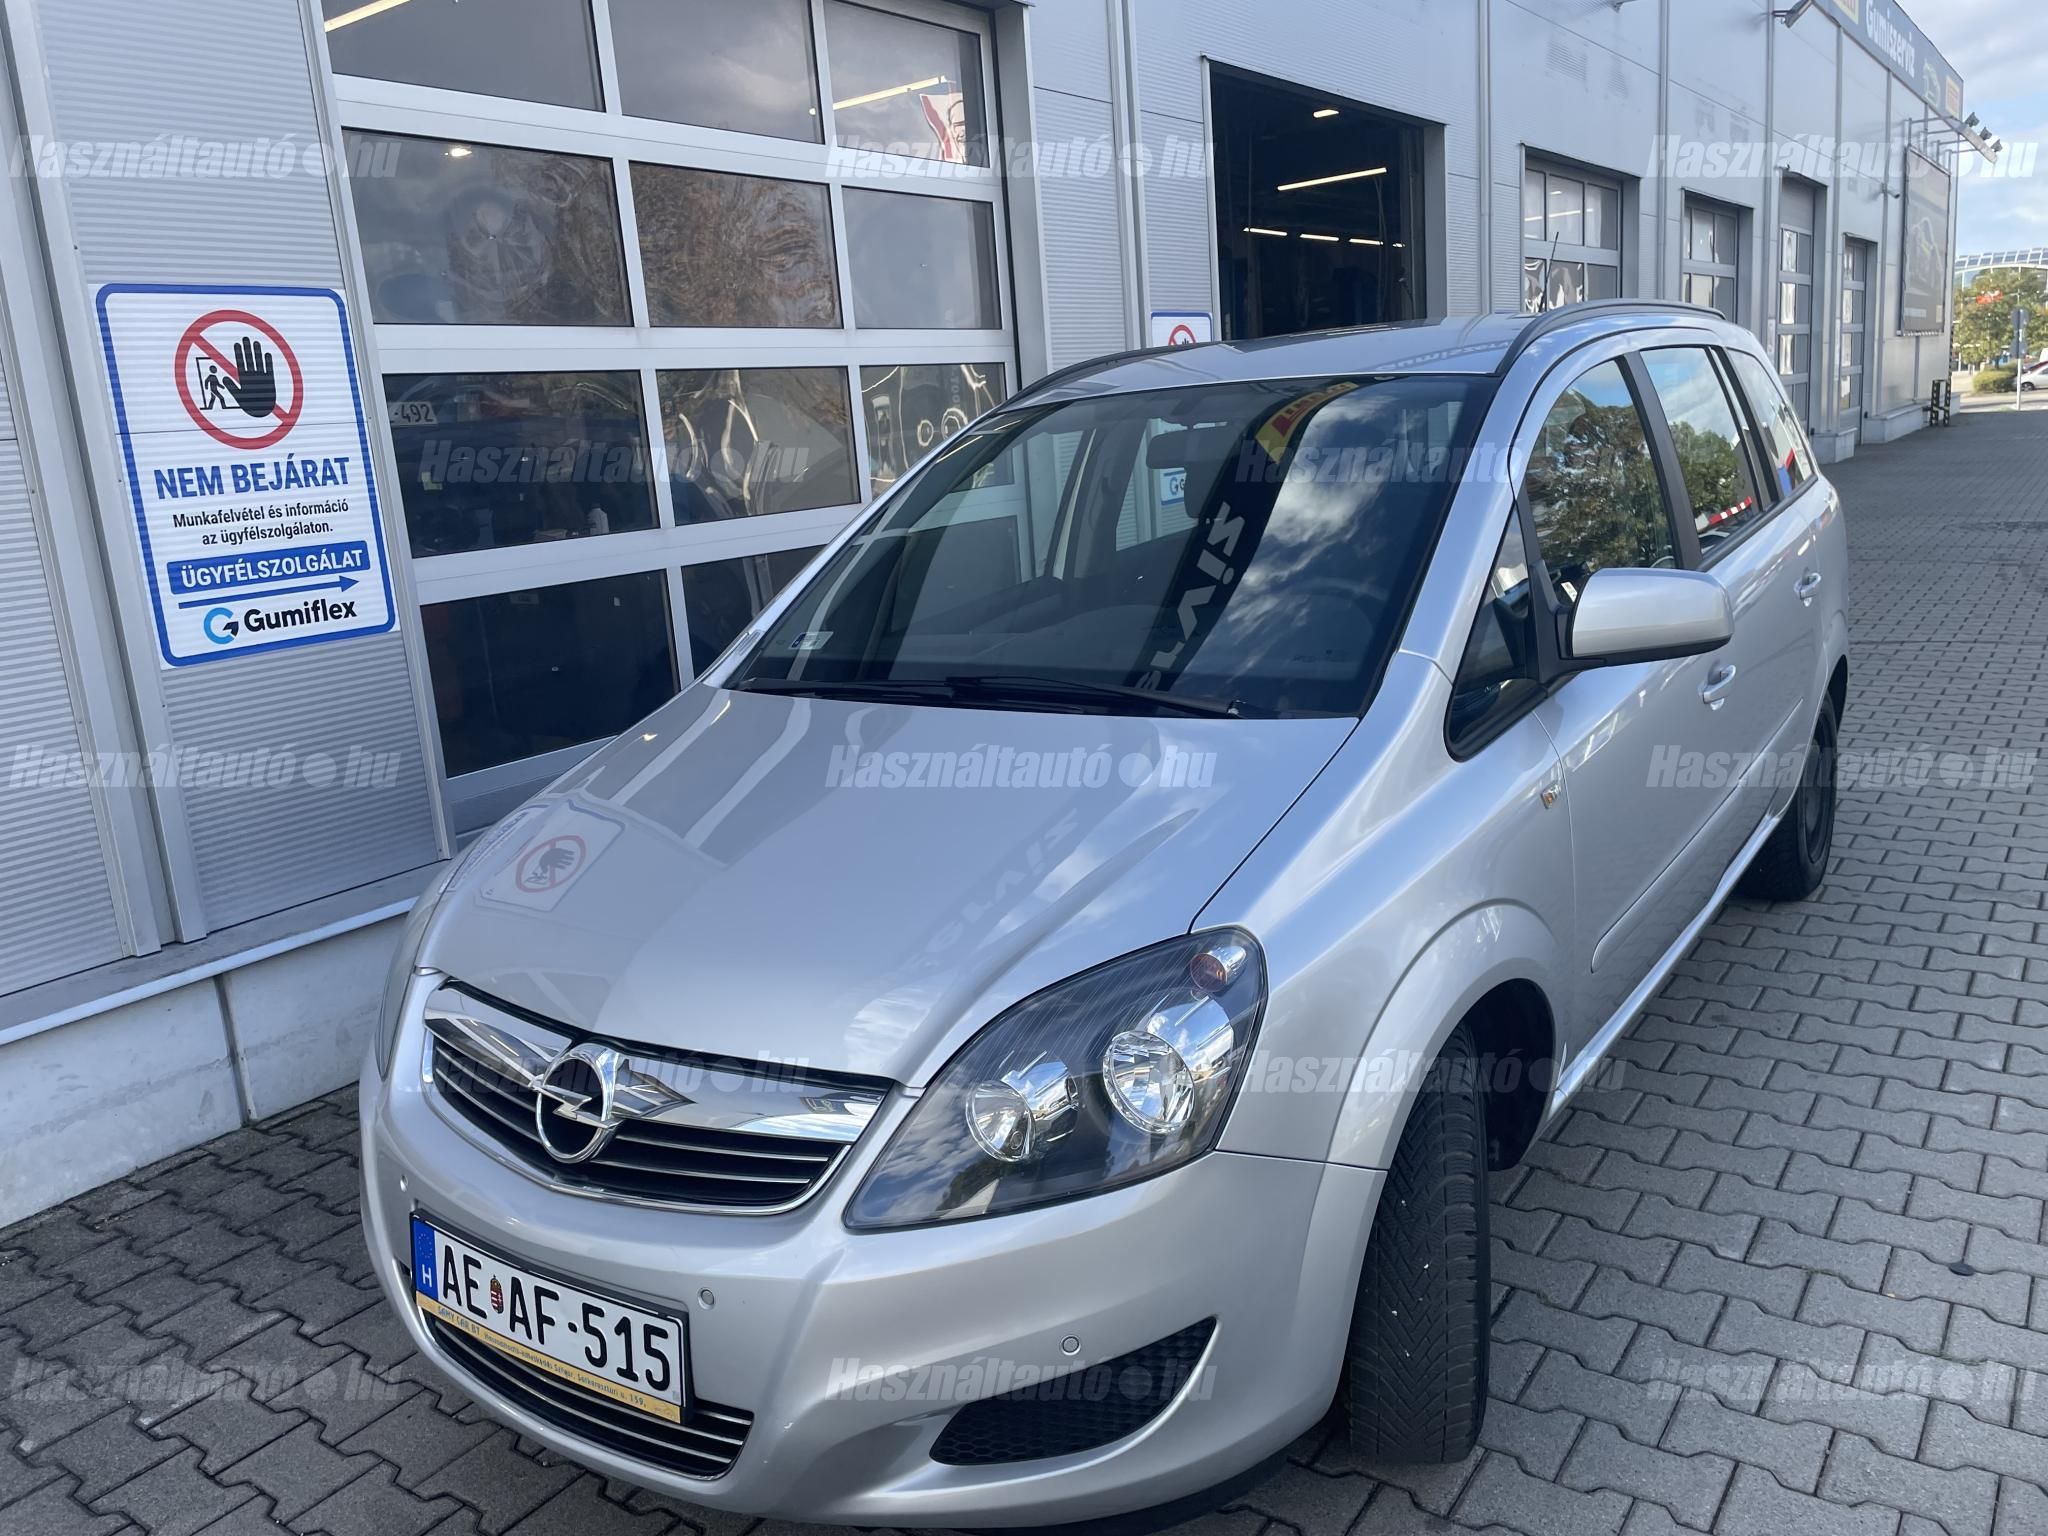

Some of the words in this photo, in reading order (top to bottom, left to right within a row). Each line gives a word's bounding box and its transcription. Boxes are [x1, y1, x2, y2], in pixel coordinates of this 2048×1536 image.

[1865, 0, 1915, 78] Gumiszerviz
[154, 465, 225, 500] NEM
[231, 453, 350, 493] BEJÁRAT
[173, 504, 265, 528] Munkafelvétel
[268, 503, 283, 519] és
[285, 499, 349, 517] információ
[202, 533, 217, 546] az
[221, 520, 334, 545] ügyfélszolgálaton.
[181, 548, 363, 589] ÜGYFÉLSZOLGÁLAT
[244, 598, 358, 632] Gumiflex
[421, 1263, 432, 1288] H
[443, 1245, 487, 1319] AE
